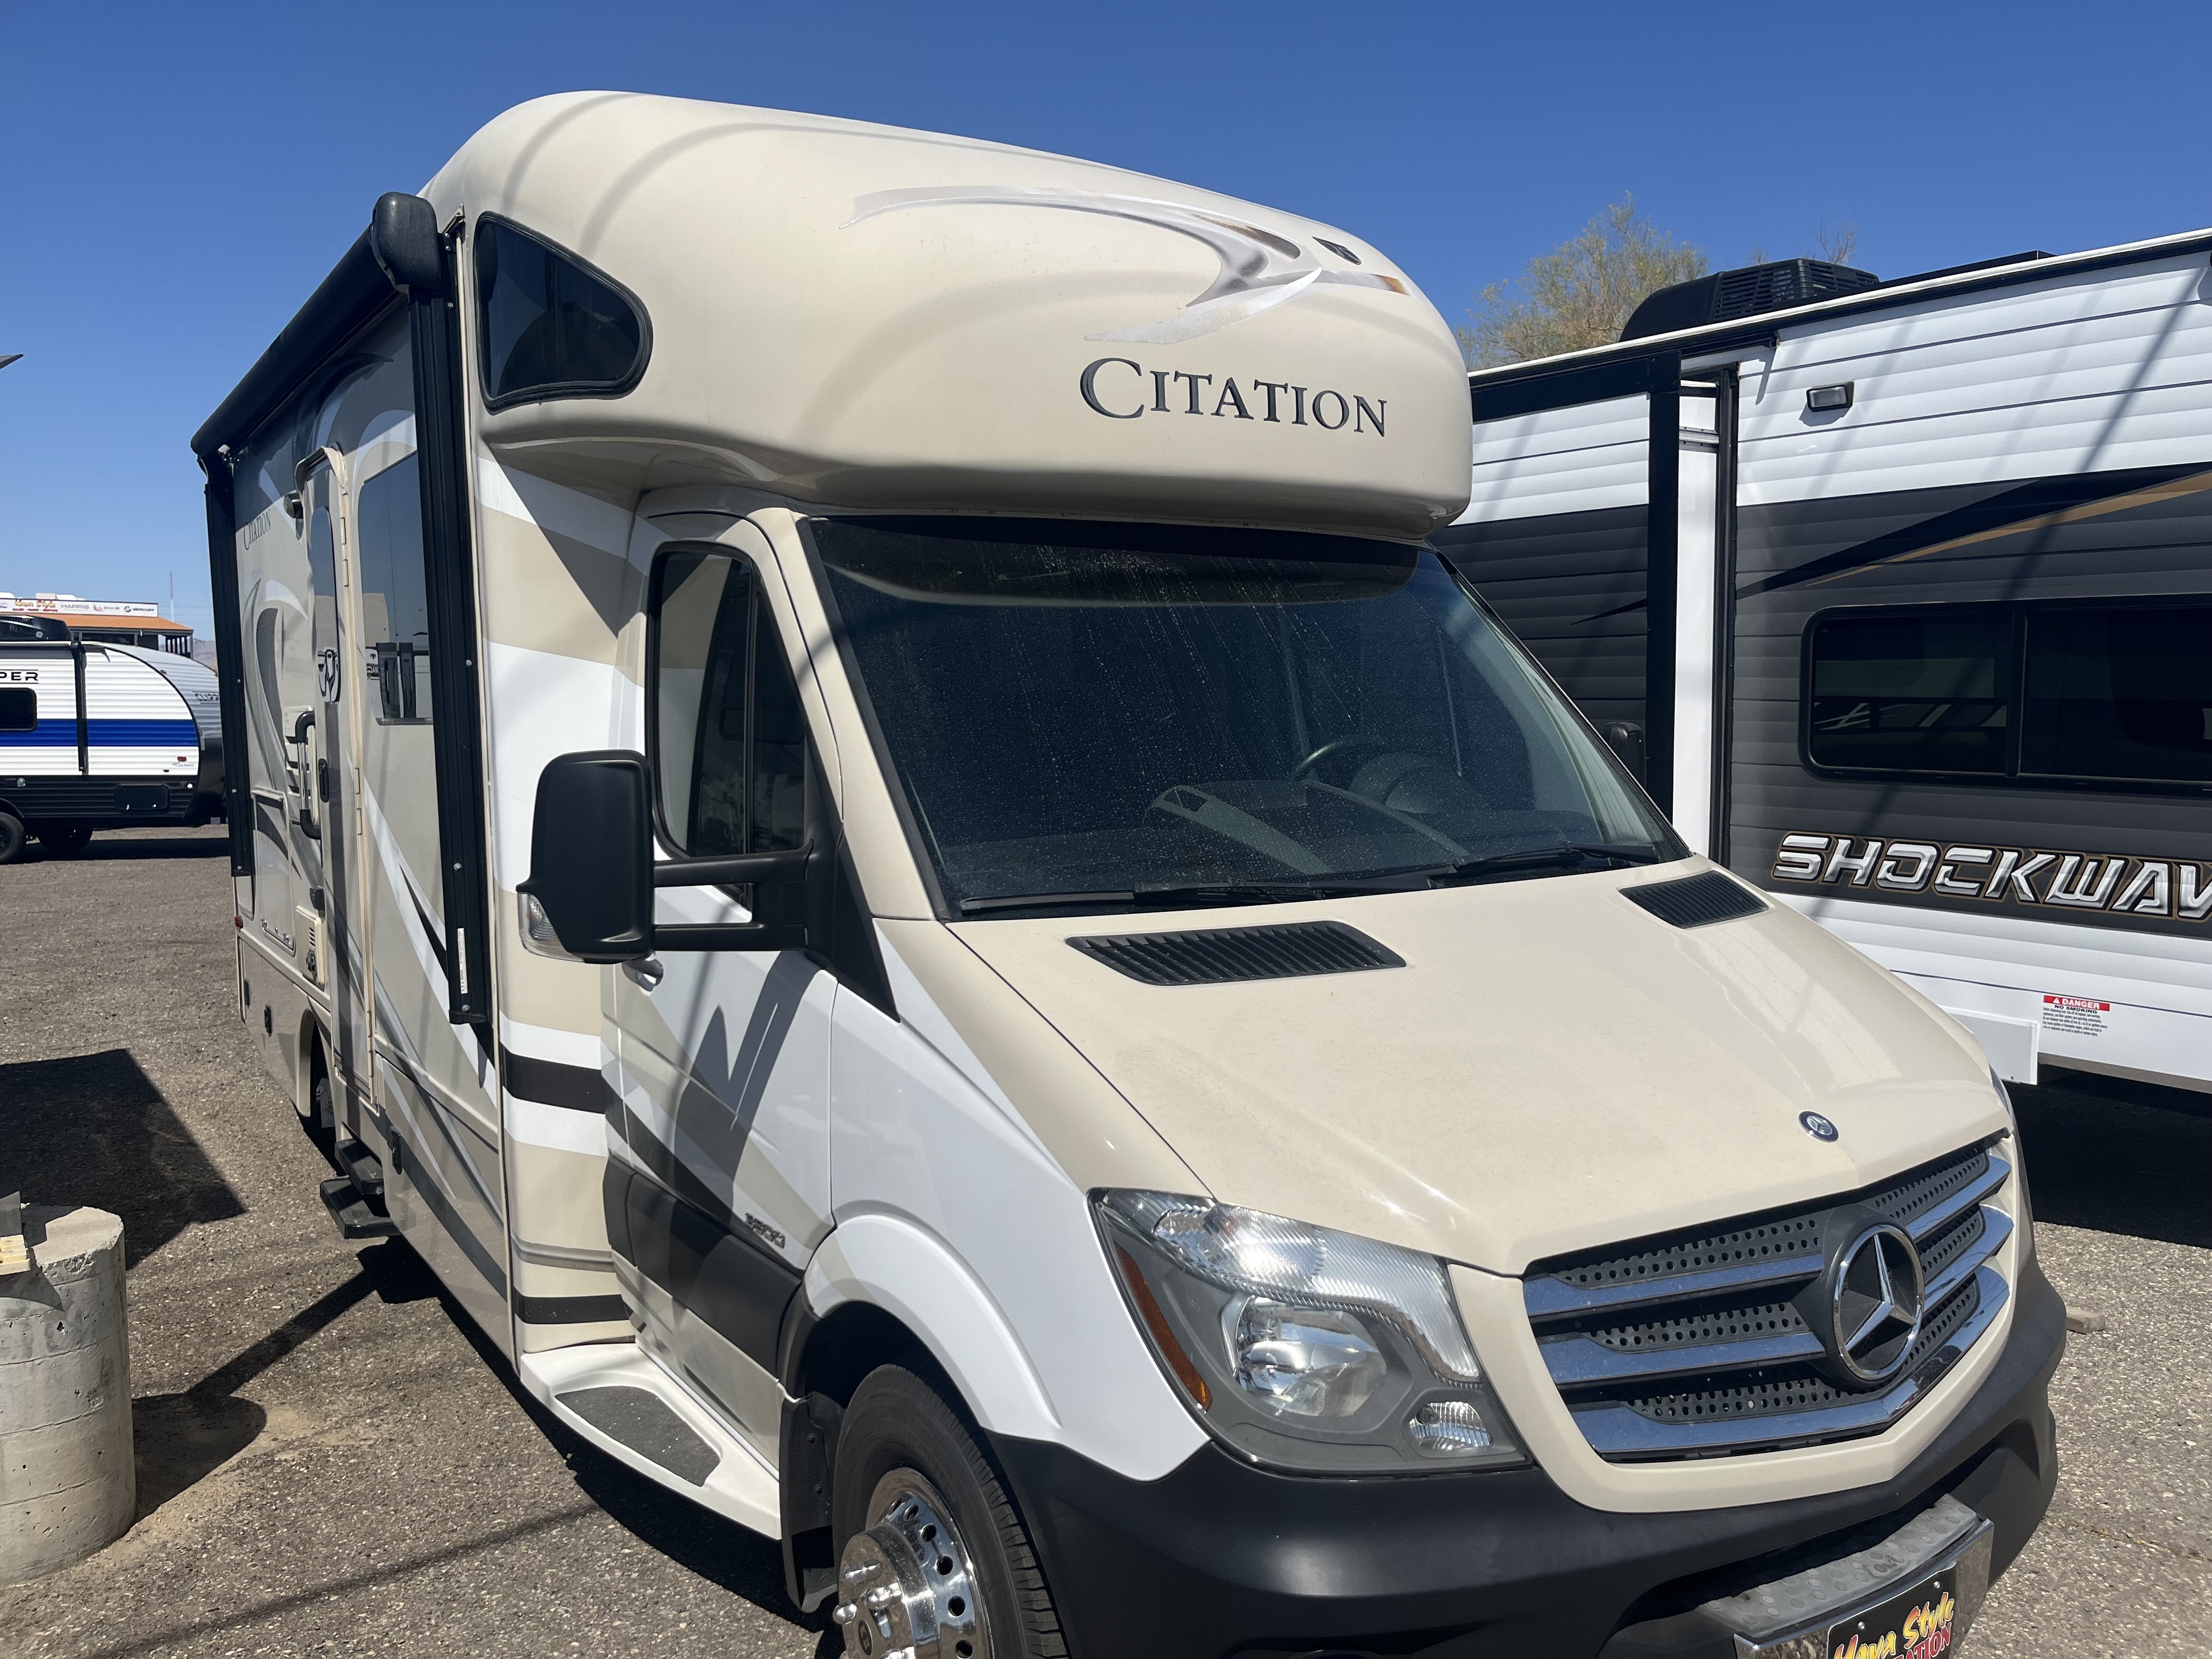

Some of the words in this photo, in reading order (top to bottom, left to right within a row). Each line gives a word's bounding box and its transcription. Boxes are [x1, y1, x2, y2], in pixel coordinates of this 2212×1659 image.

[1080, 358, 1387, 437] CITATION
[2062, 998, 2100, 1009] DANGER
[1903, 1591, 1955, 1649] Style
